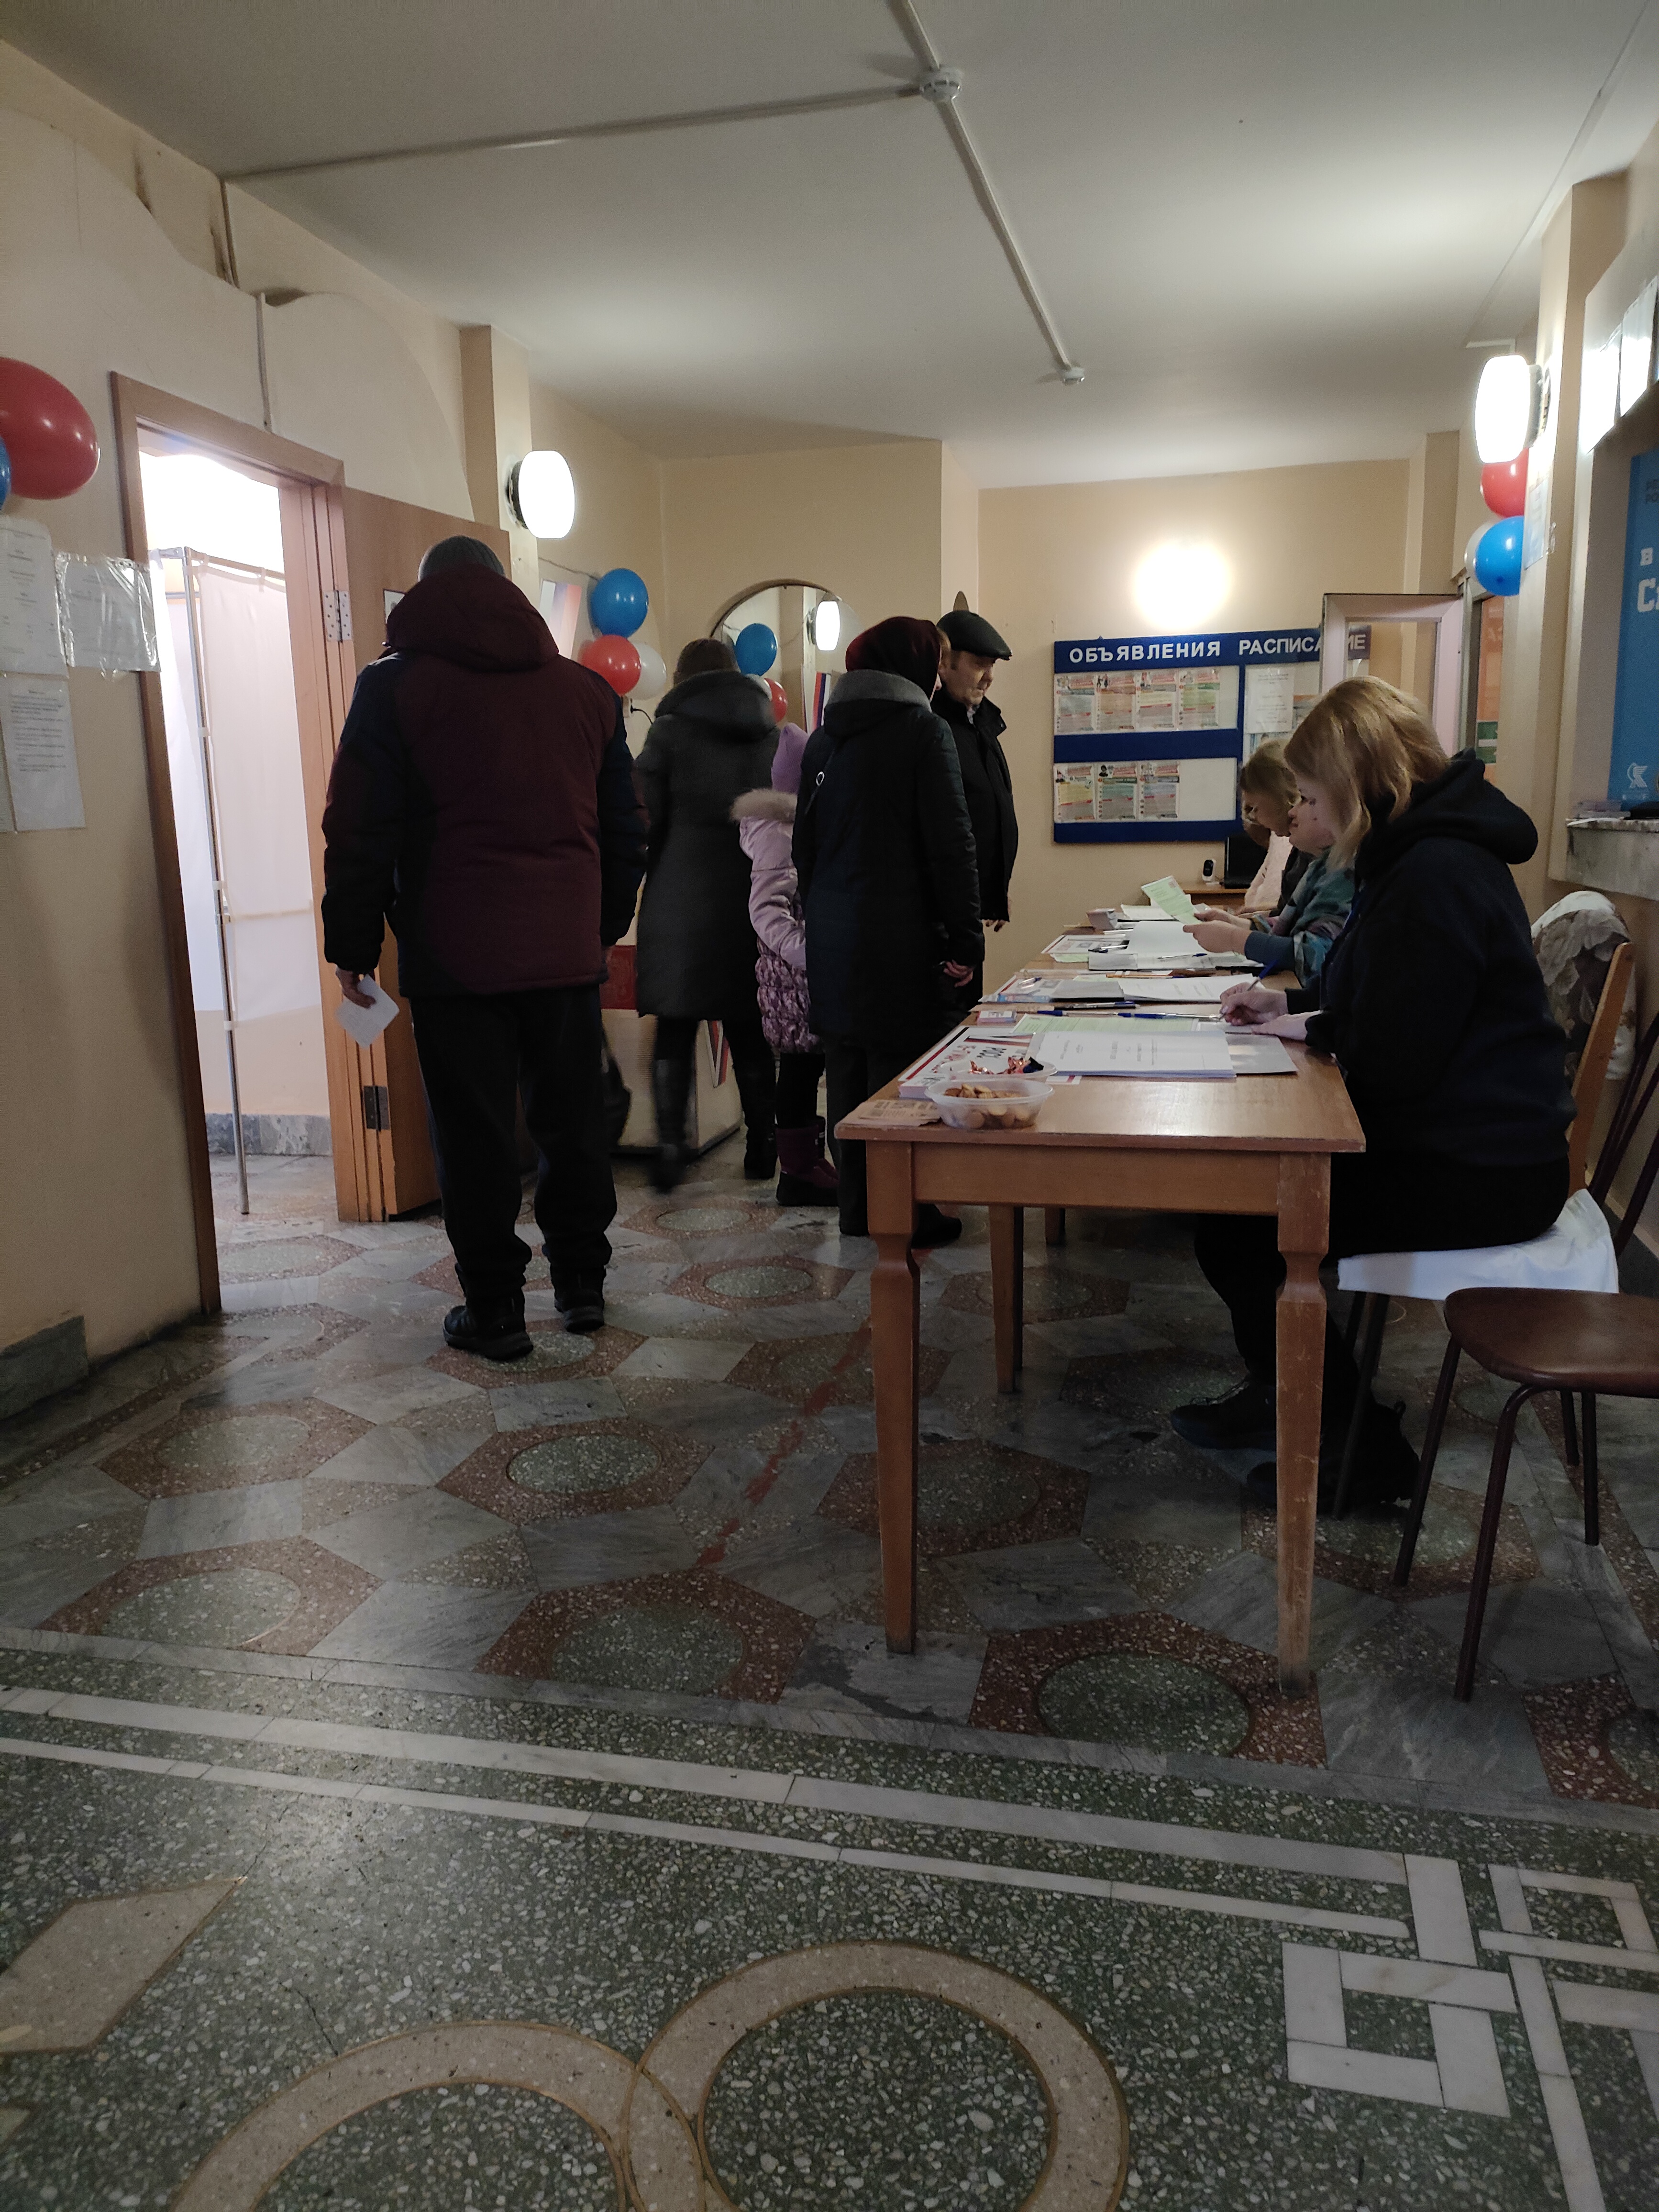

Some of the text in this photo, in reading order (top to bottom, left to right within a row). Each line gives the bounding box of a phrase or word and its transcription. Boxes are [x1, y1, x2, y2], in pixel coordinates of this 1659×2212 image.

[1637, 577, 1659, 613] С
[1069, 641, 1220, 663] ОБЪЯВЛЕНИЯ
[1239, 634, 1366, 655] РАСПИСИЕ
